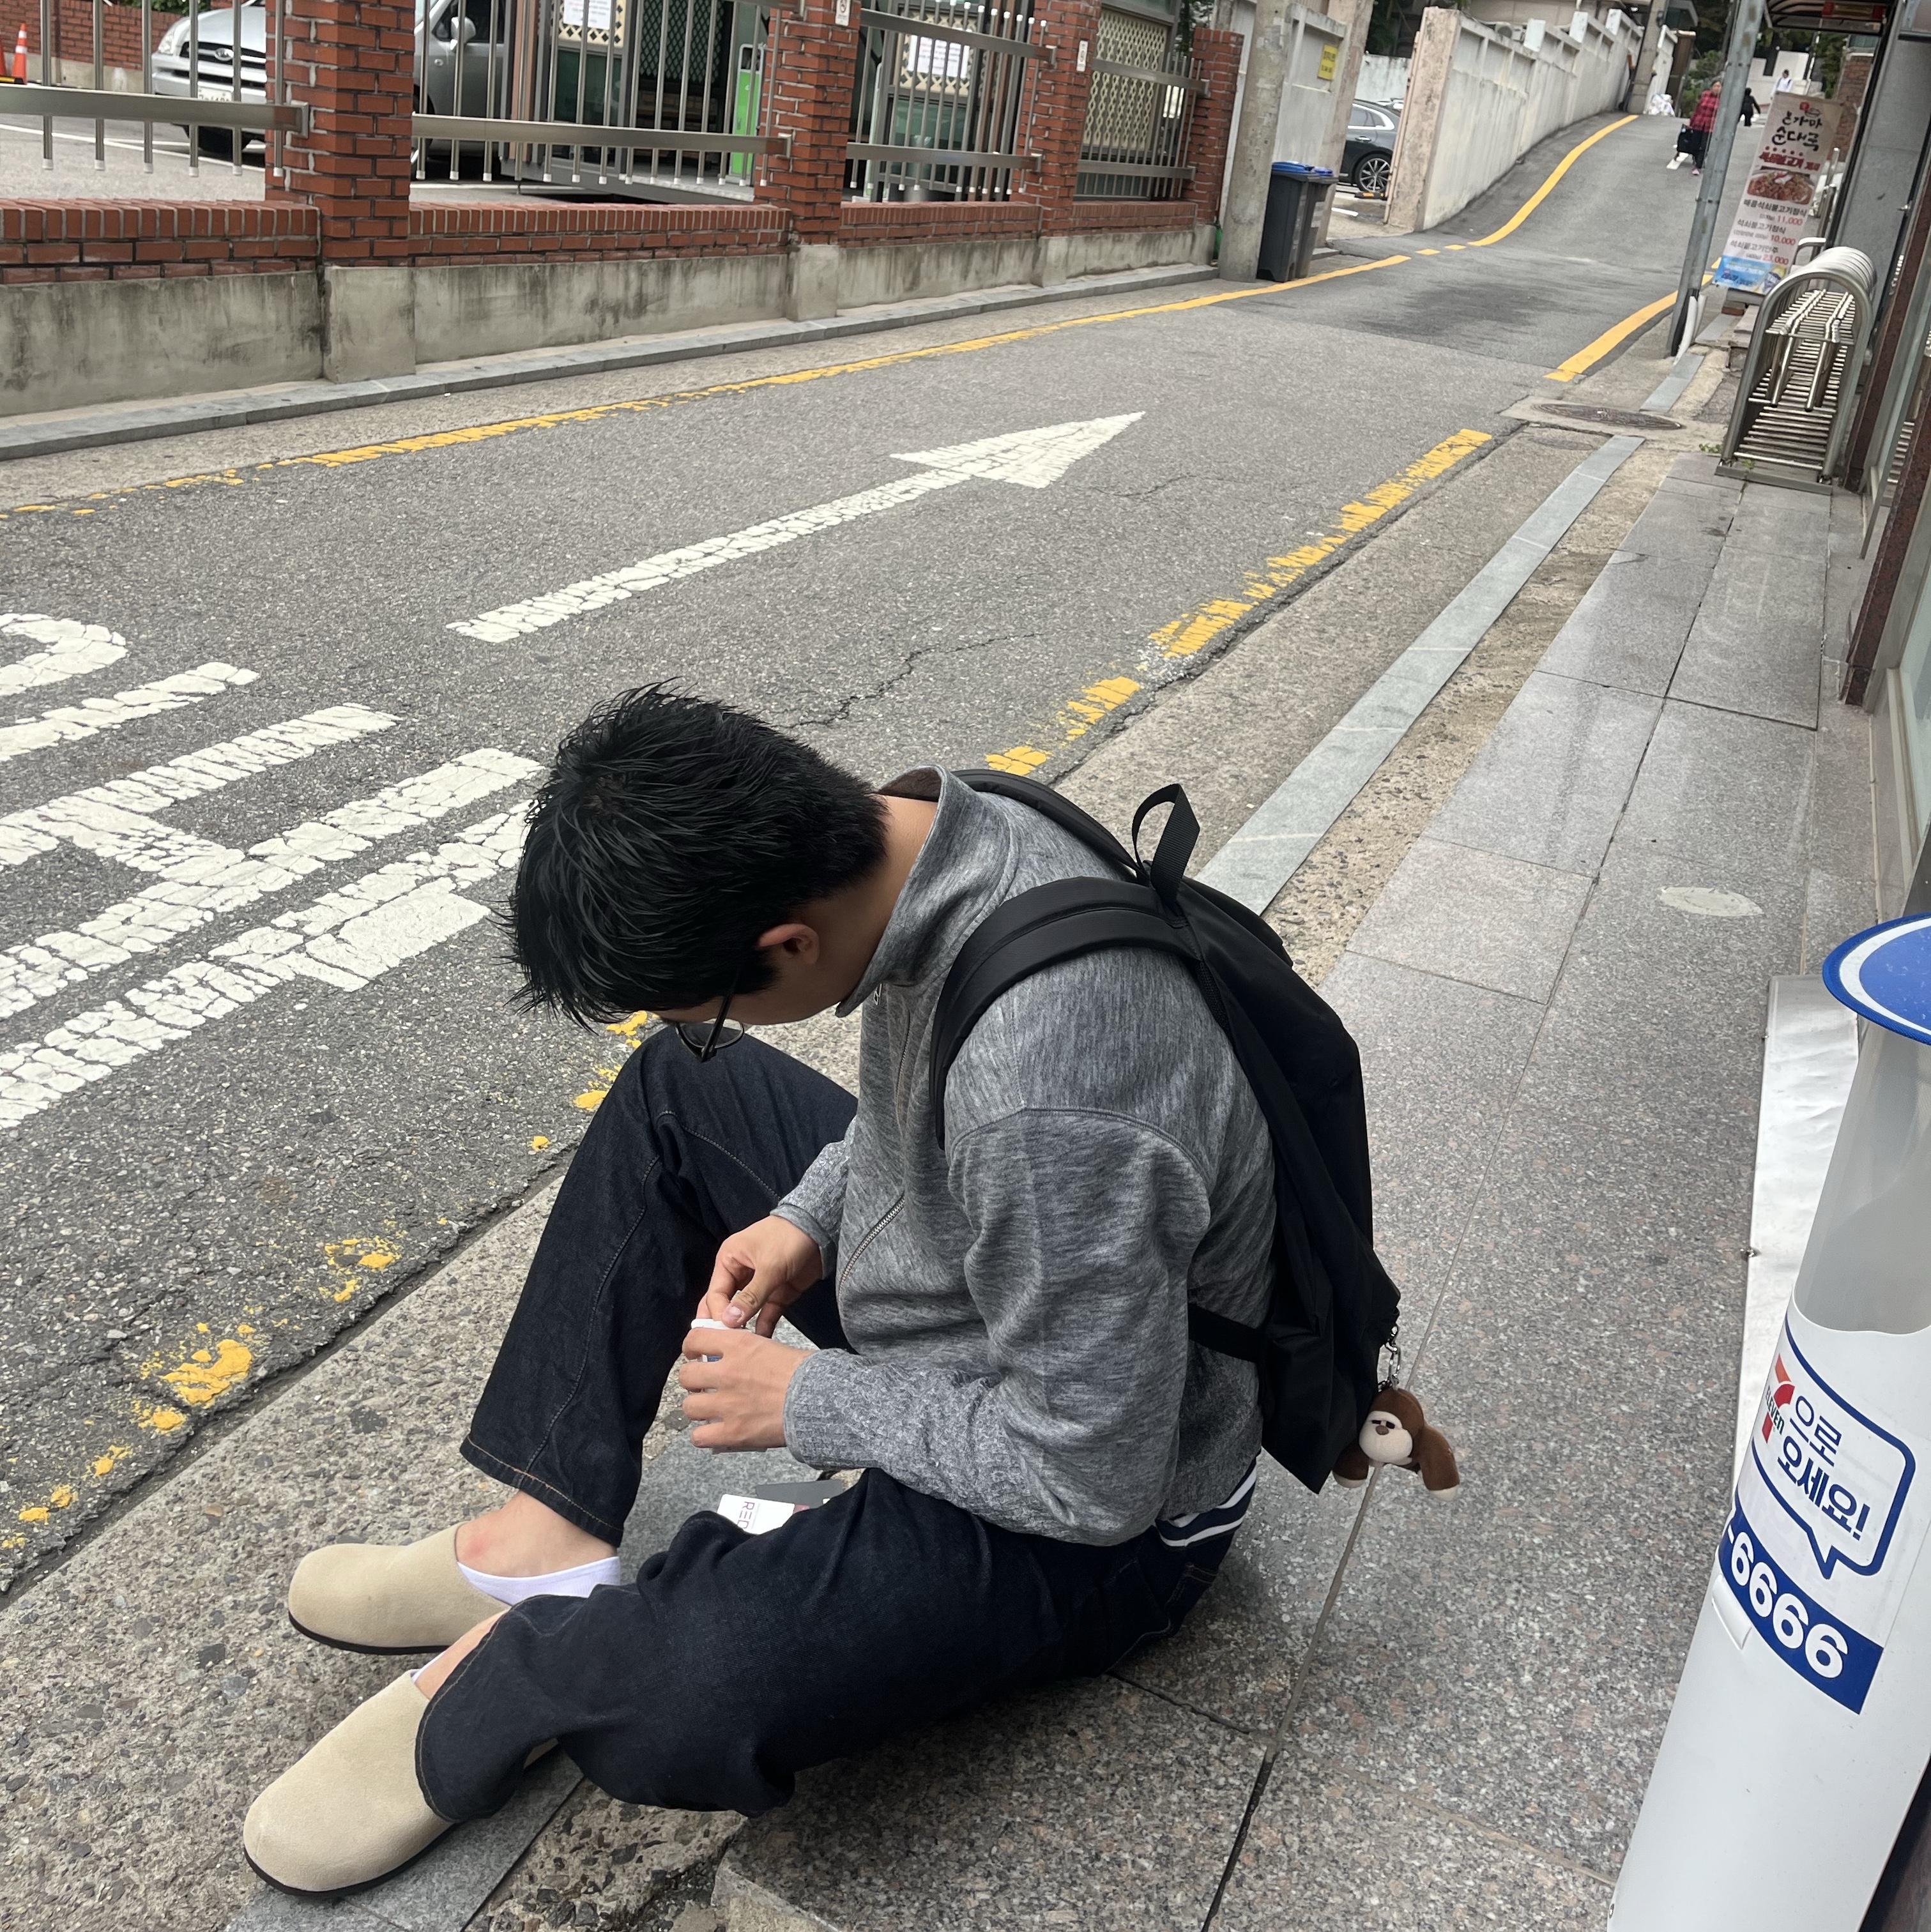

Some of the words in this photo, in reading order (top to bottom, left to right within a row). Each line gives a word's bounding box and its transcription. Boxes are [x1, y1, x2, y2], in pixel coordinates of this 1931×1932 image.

[1772, 126, 1819, 151] 순대국
[1778, 215, 1803, 225] 11,000
[1771, 234, 1796, 245] 10,000
[1789, 1396, 1842, 1467] 으로
[1777, 1435, 1871, 1541] 오세요!
